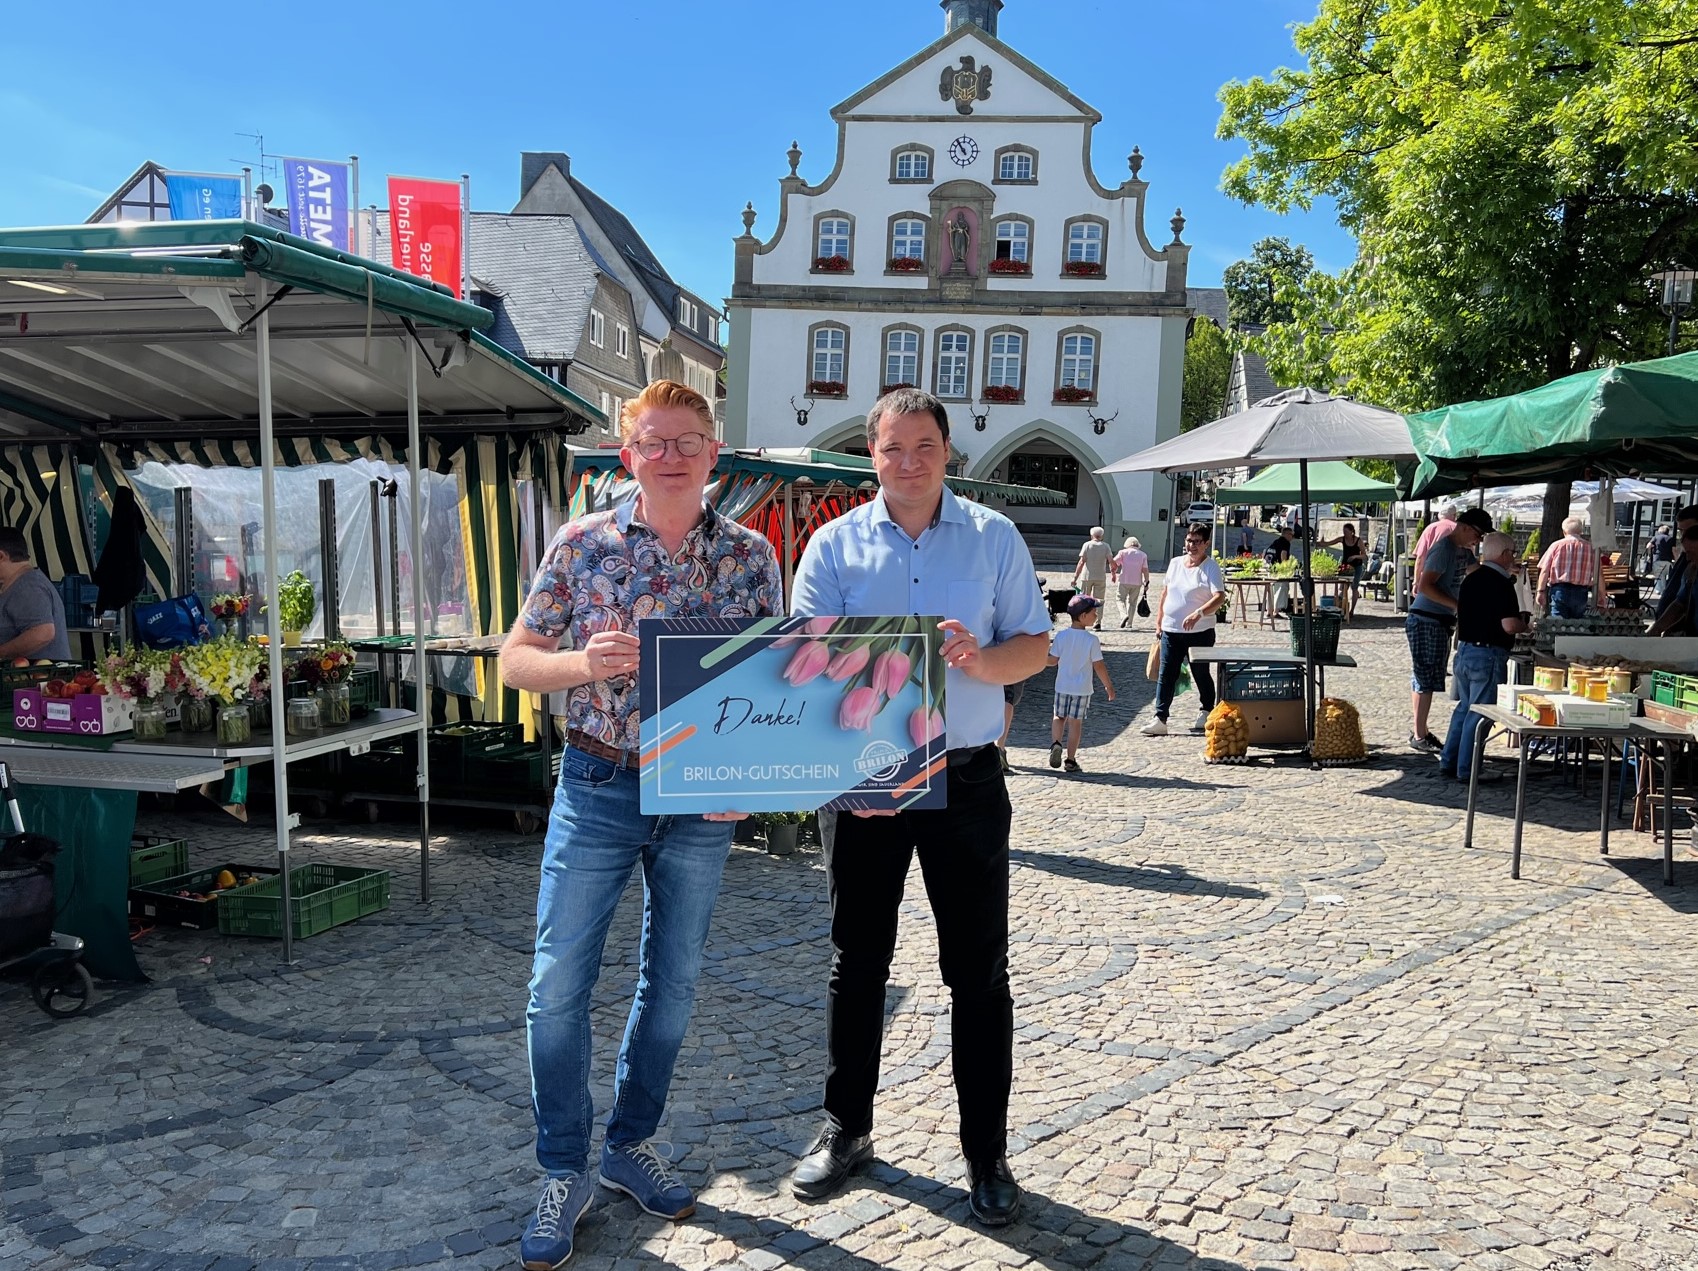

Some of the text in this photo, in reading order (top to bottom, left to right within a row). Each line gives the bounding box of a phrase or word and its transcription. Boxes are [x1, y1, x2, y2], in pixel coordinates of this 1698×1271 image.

[713, 695, 807, 736] Danke!
[857, 751, 905, 770] BRILON
[683, 764, 840, 781] BRILON-GUTSCHEIN
